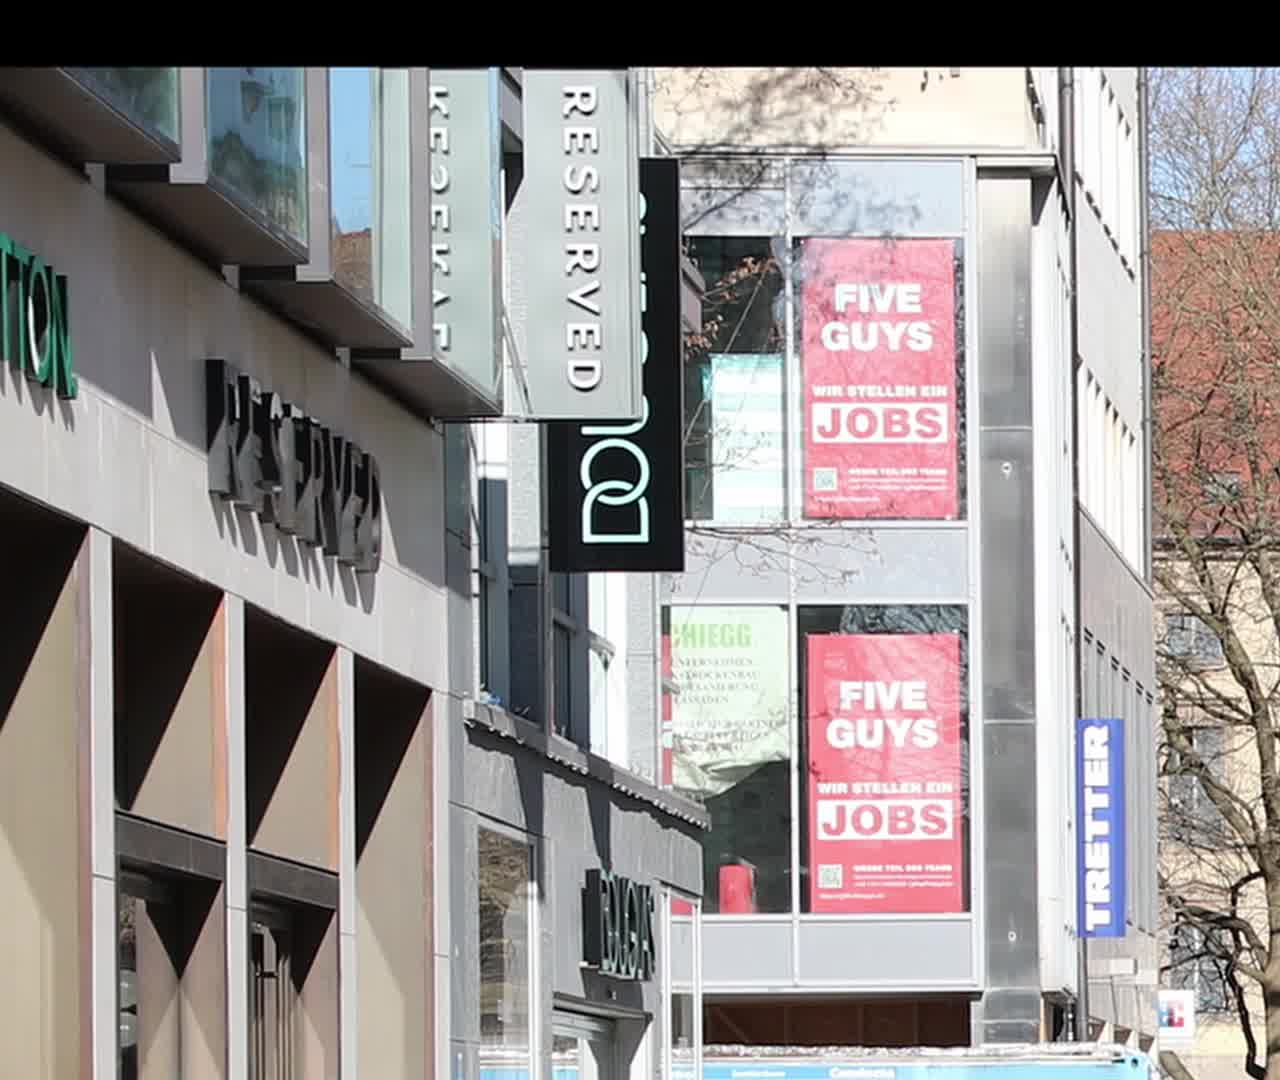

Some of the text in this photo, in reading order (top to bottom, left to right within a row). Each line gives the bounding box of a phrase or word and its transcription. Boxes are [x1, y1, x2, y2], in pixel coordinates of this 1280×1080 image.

[562, 85, 601, 392] RESERVED
[834, 283, 922, 313] FIVE
[821, 321, 933, 351] GUYS
[812, 385, 947, 397] WIR STELLEN EIN
[817, 407, 942, 438] JOBS
[839, 680, 928, 711] FIVE
[826, 718, 938, 749] GUYS
[817, 782, 952, 794] WIR STELLEN EIN
[822, 804, 948, 836] JOBS
[1084, 725, 1111, 931] TRETTER
